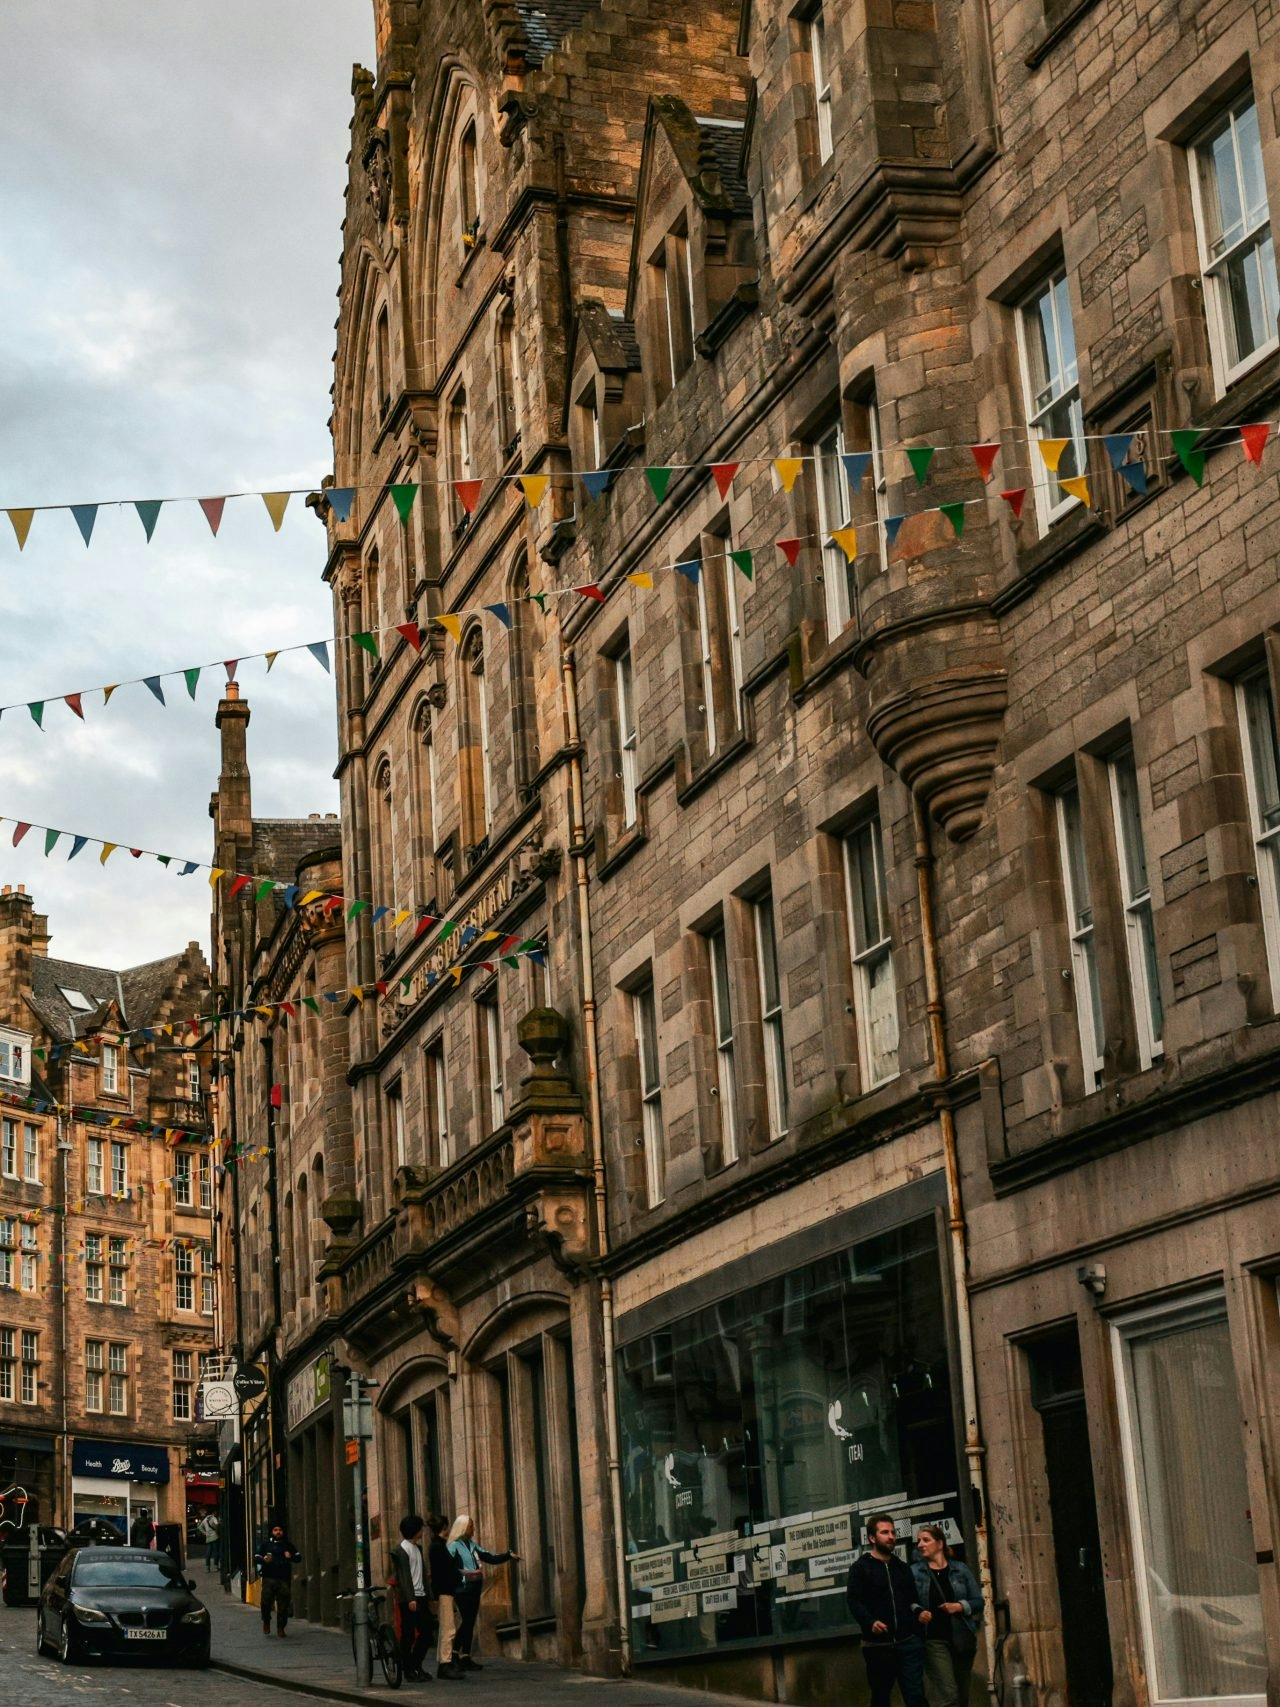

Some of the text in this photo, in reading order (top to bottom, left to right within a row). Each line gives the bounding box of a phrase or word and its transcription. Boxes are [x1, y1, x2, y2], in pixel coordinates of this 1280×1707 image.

[85, 1459, 103, 1468] Health
[111, 1458, 131, 1474] Boots
[141, 1464, 159, 1475] Beauty
[814, 1524, 825, 1536] PRESS
